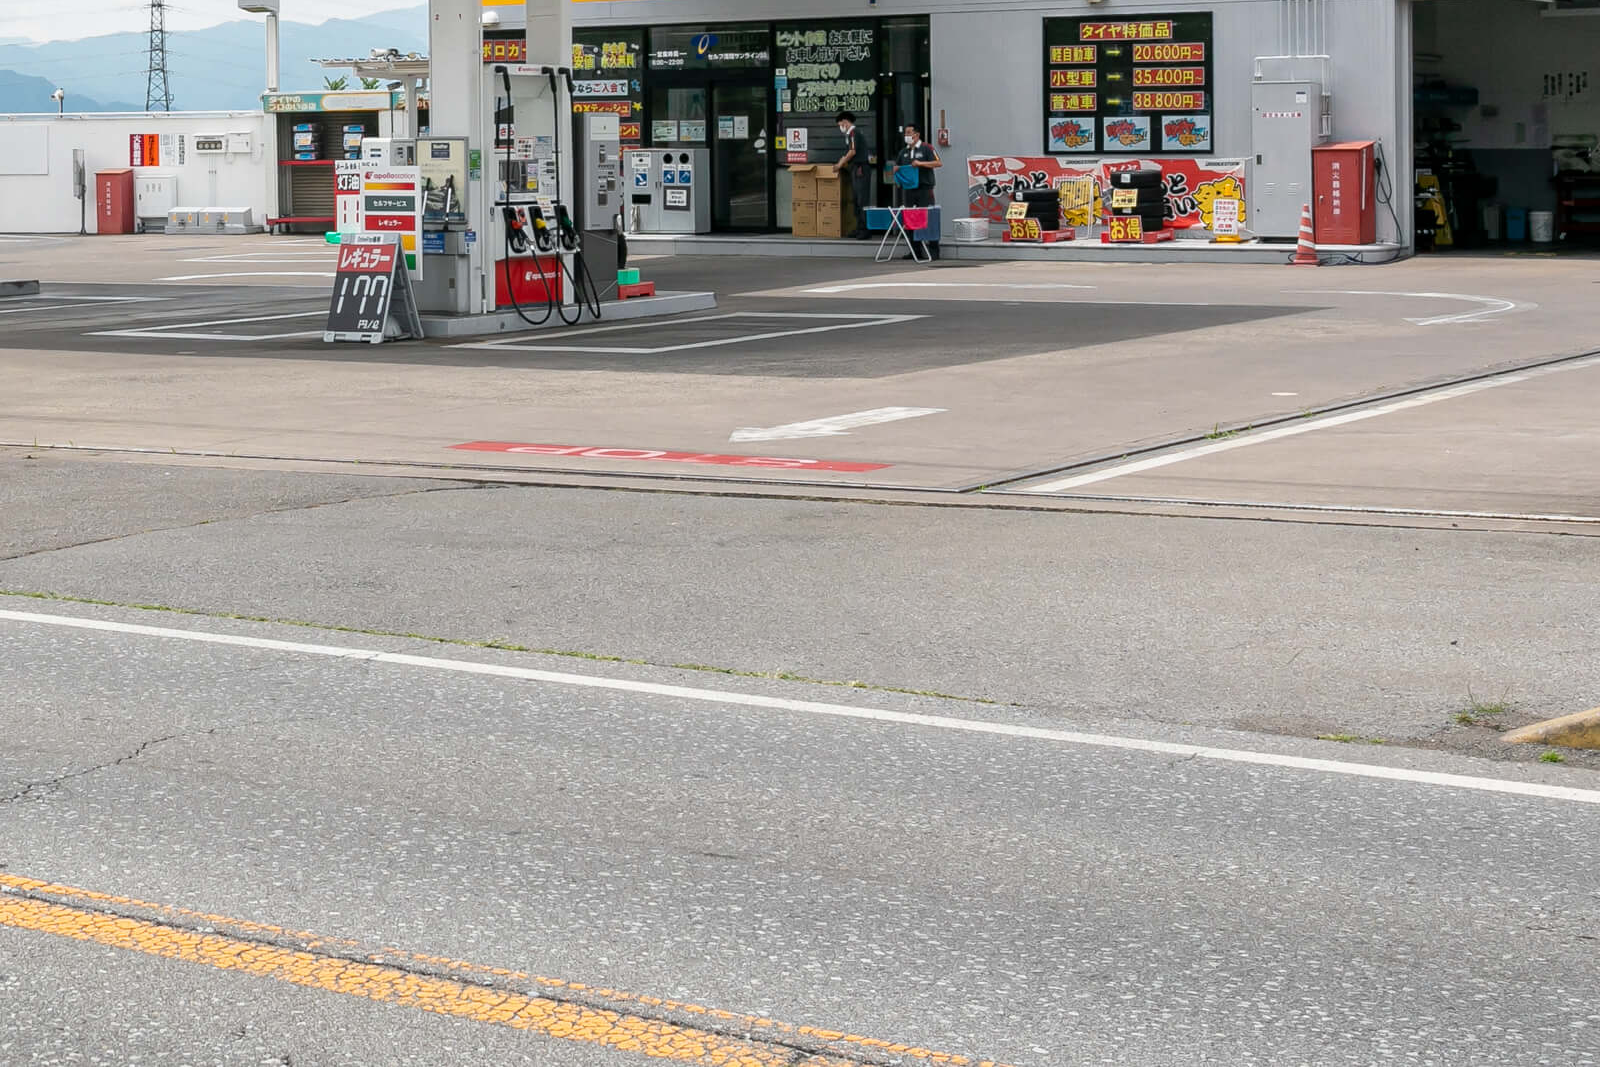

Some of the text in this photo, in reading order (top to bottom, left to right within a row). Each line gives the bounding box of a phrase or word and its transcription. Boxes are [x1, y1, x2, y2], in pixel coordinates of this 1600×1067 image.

[1082, 22, 1170, 39] タイヤ特価品
[1051, 47, 1094, 63] 軽自動車
[1052, 70, 1094, 87] 小型車
[1052, 94, 1094, 110] 普通車
[793, 130, 801, 141] R
[984, 171, 1049, 195] ちゃんと
[373, 199, 408, 208] セルフサービス
[378, 219, 403, 227] レギュラー
[1011, 219, 1040, 239] お得
[1111, 217, 1141, 240] お得
[339, 247, 392, 270] レギュラー
[336, 274, 389, 315] 177
